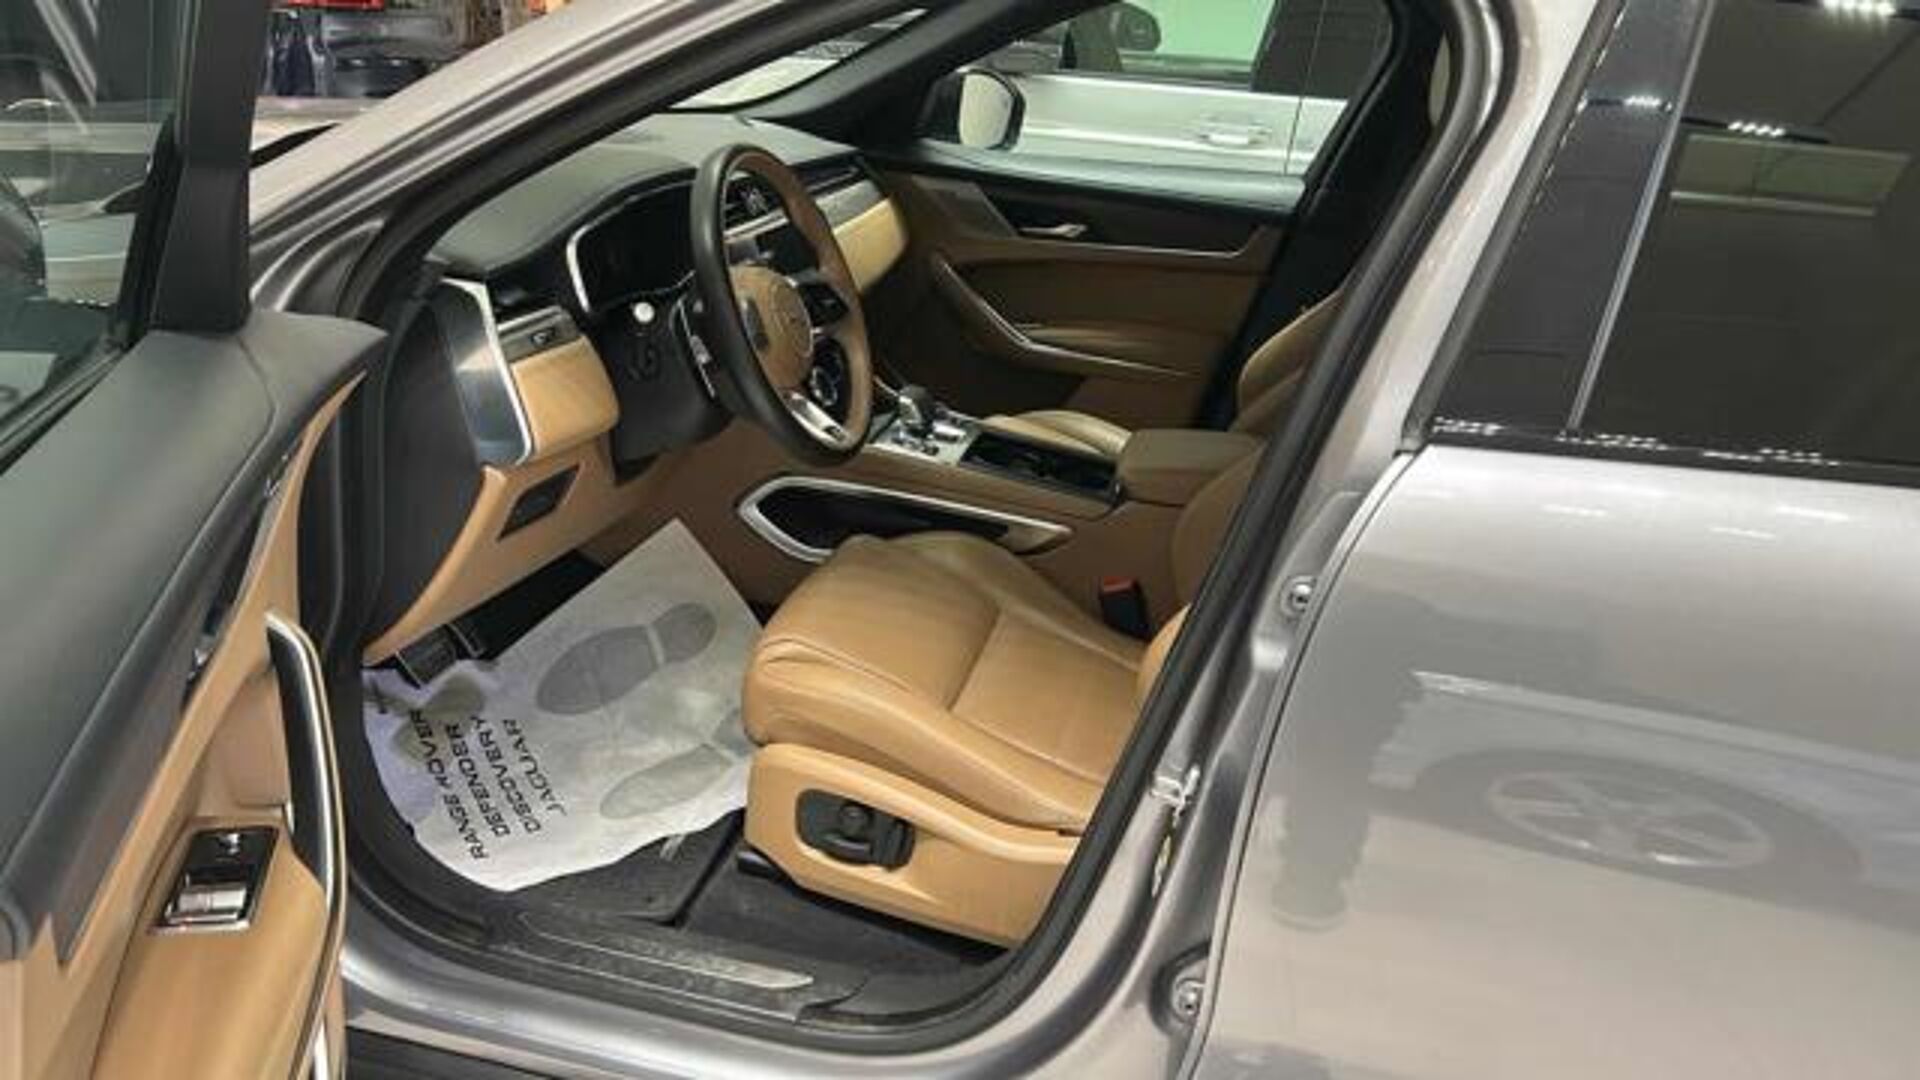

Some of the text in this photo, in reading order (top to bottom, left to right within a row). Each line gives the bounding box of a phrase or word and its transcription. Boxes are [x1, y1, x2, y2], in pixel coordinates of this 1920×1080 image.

[409, 709, 489, 860] RANGE ROVER
[445, 722, 511, 838] DEFENDER
[470, 715, 541, 833] DISCOVERY
[503, 718, 567, 816] JAGUAR
